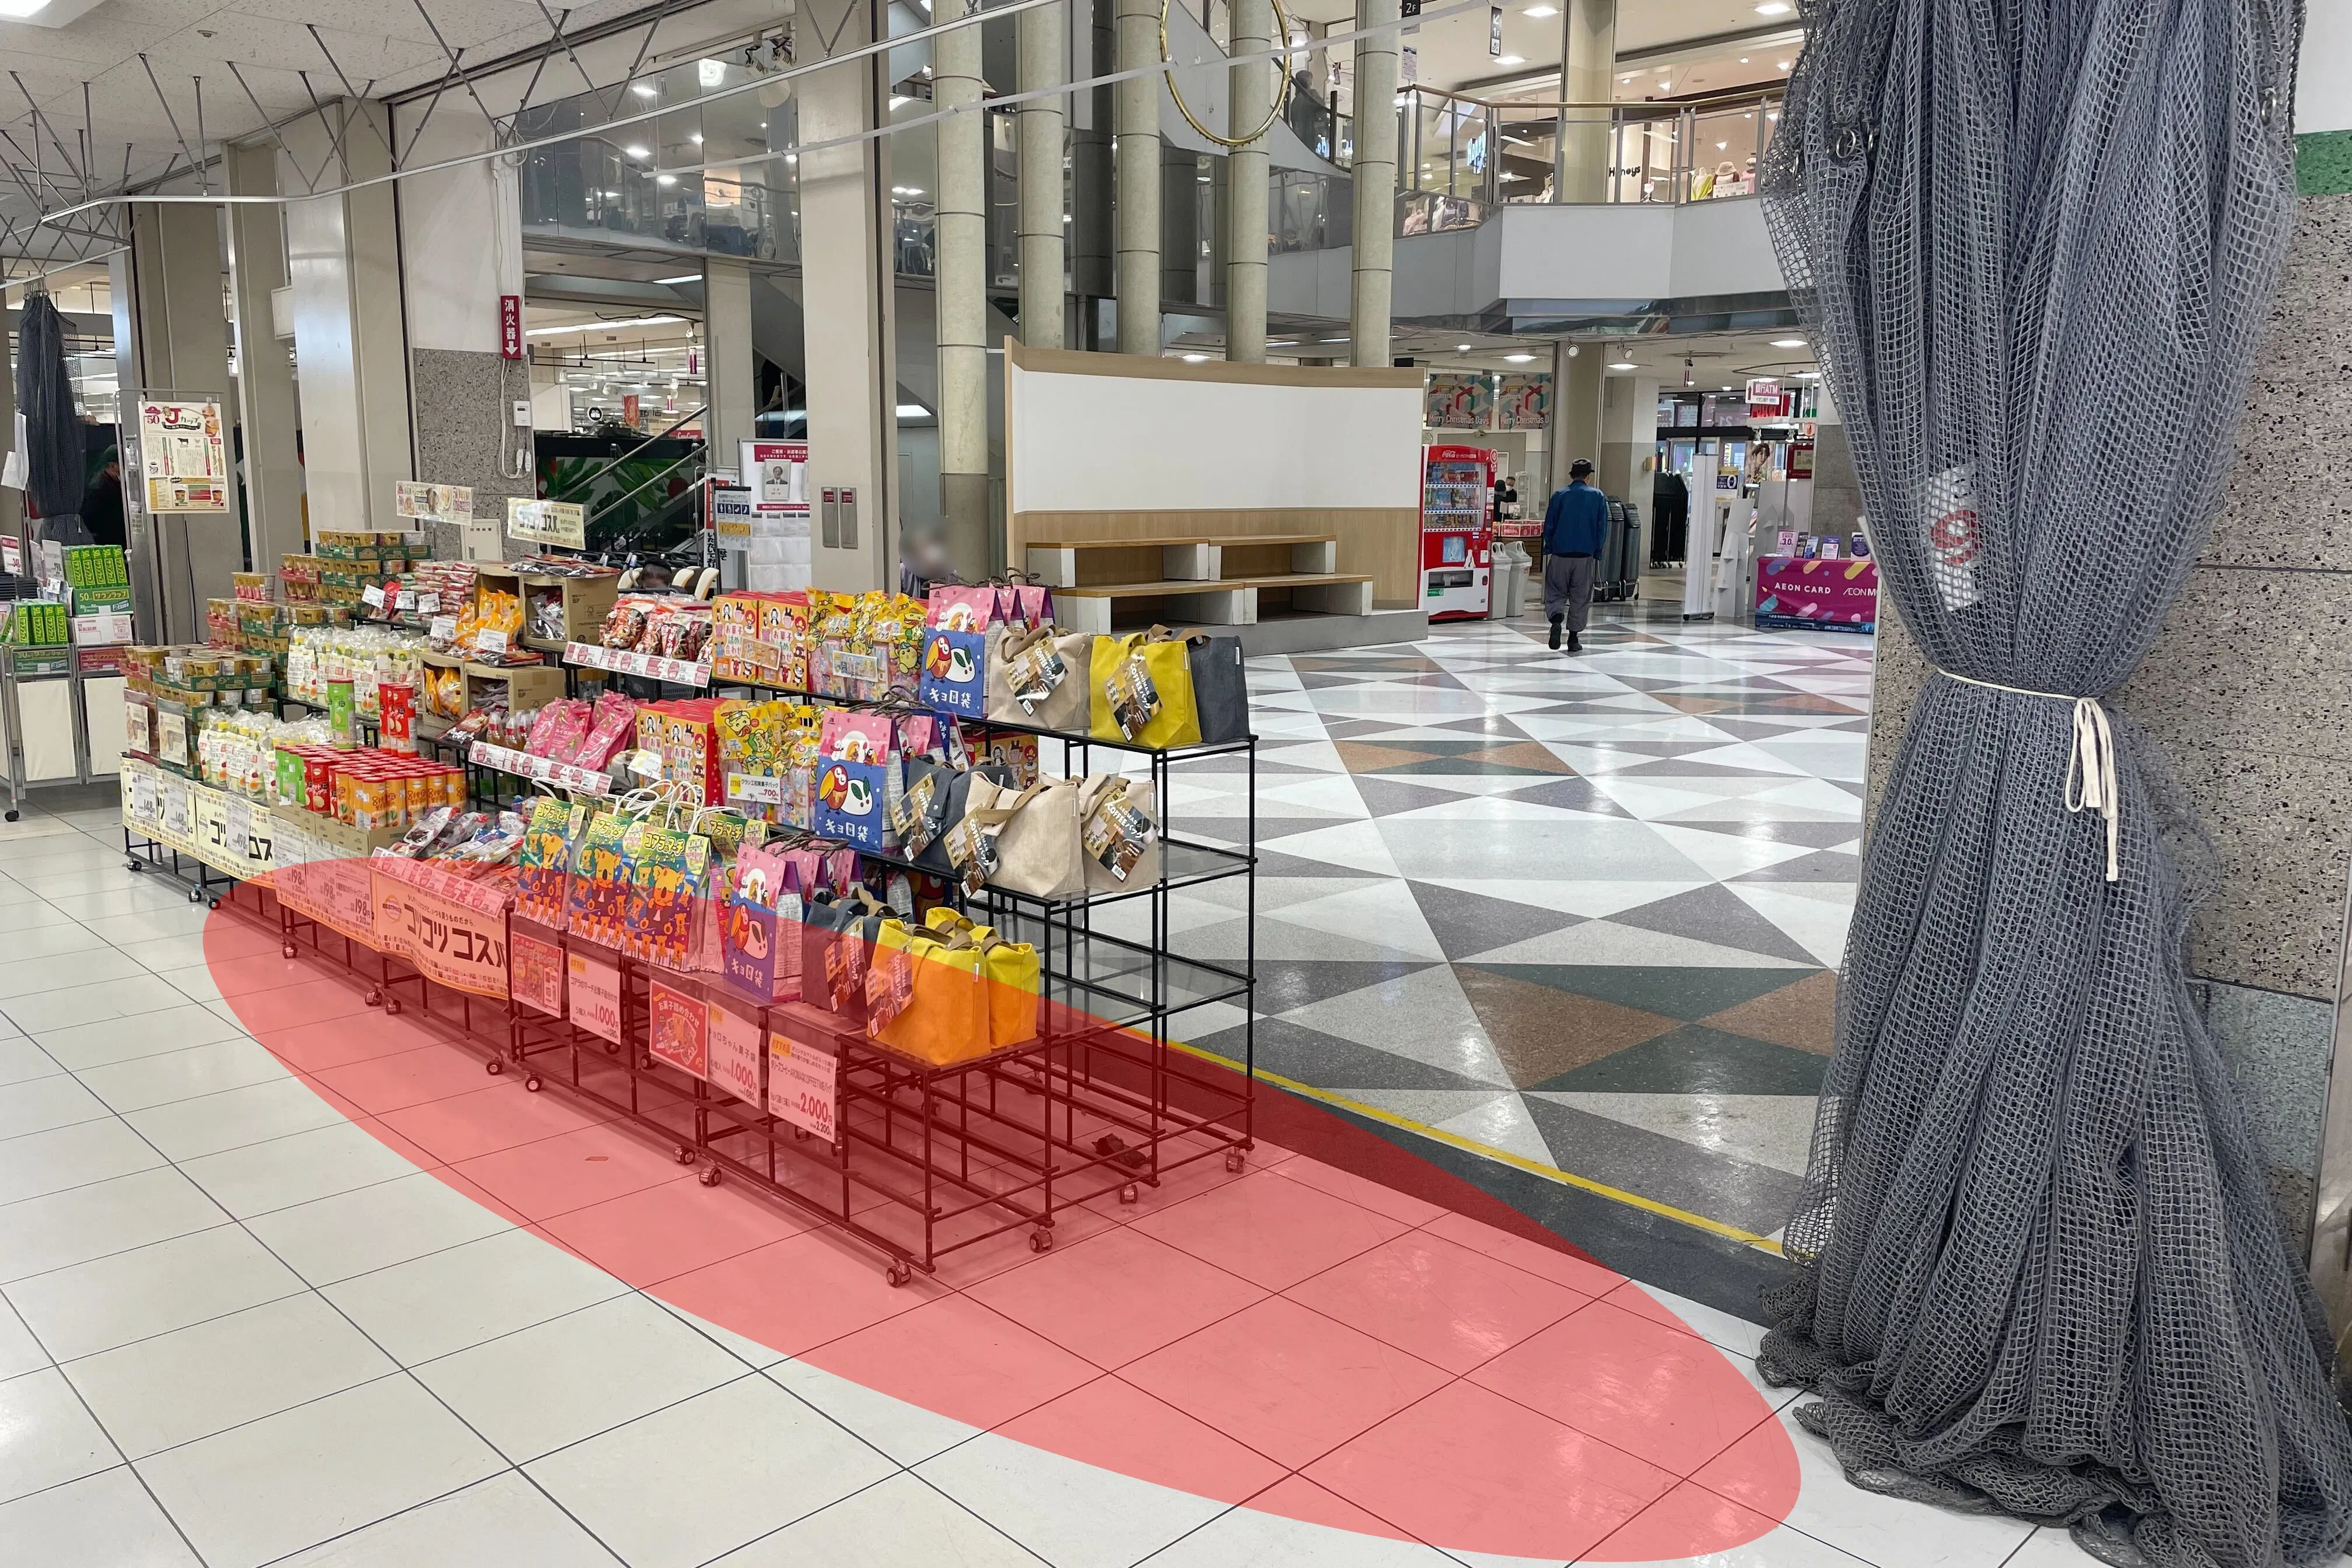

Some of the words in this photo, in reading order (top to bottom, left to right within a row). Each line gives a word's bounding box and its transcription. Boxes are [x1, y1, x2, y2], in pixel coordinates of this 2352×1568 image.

[1406, 3, 1416, 13] 2F
[1493, 28, 1500, 37] 1F
[1609, 166, 1640, 177] Hneys
[505, 299, 516, 340] 消火器
[1429, 415, 1444, 424] Merry
[1446, 415, 1475, 424] Christmas
[1475, 415, 1489, 425] Days
[1501, 416, 1515, 426] Merry
[1517, 415, 1544, 424] Christmas
[1774, 582, 1801, 592] AEON
[1804, 585, 1831, 594] CARD
[595, 1003, 619, 1030] 1,000円
[658, 1000, 700, 1028] お菓子詰め合わせ
[731, 1059, 757, 1093] 1,000円
[800, 1091, 832, 1126] 2,000円
